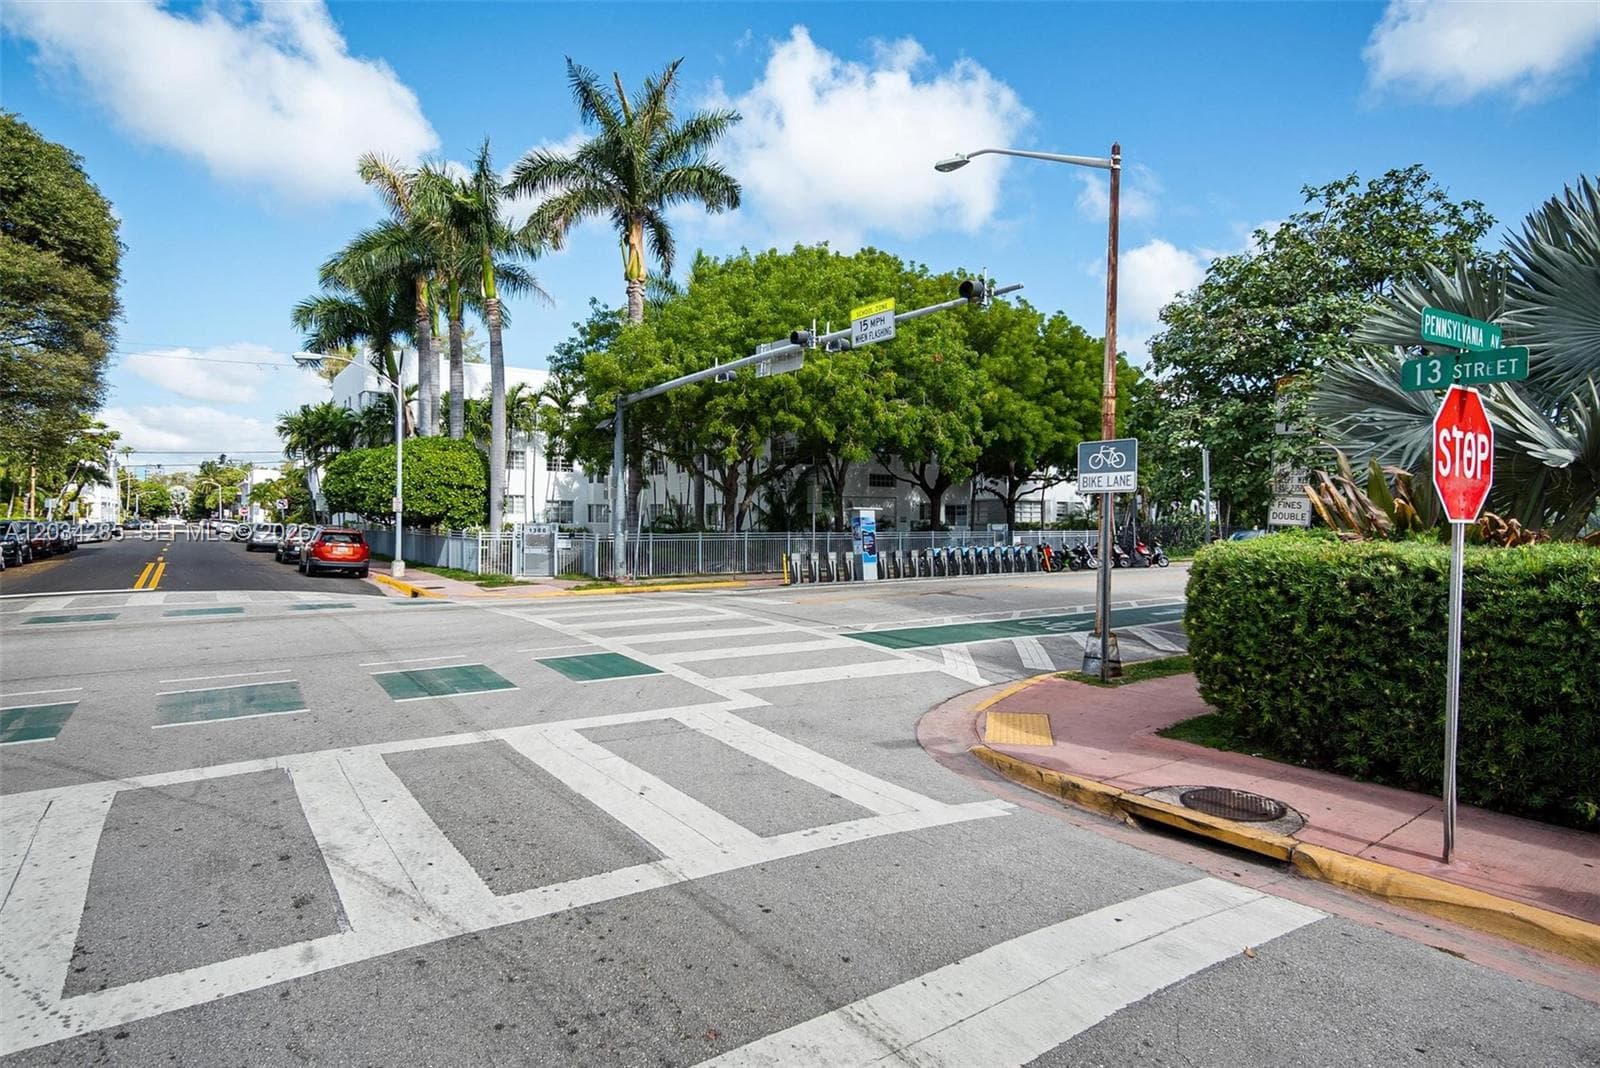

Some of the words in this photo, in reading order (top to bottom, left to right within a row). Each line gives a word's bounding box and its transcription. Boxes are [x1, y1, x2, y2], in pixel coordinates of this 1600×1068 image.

[859, 319, 869, 332] 15
[870, 316, 885, 327] MPH
[1425, 315, 1484, 348] PENNSYLVANIA
[1490, 334, 1500, 349] AV
[855, 333, 868, 343] WHEN
[868, 326, 892, 339] FLASHING
[1415, 360, 1442, 386] 13
[1452, 358, 1519, 379] STREET
[1438, 425, 1489, 480] STOP
[1082, 475, 1103, 488] BIKE
[1107, 474, 1132, 487] LANE
[1277, 501, 1302, 510] FINES
[1271, 511, 1307, 521] DOUBLE
